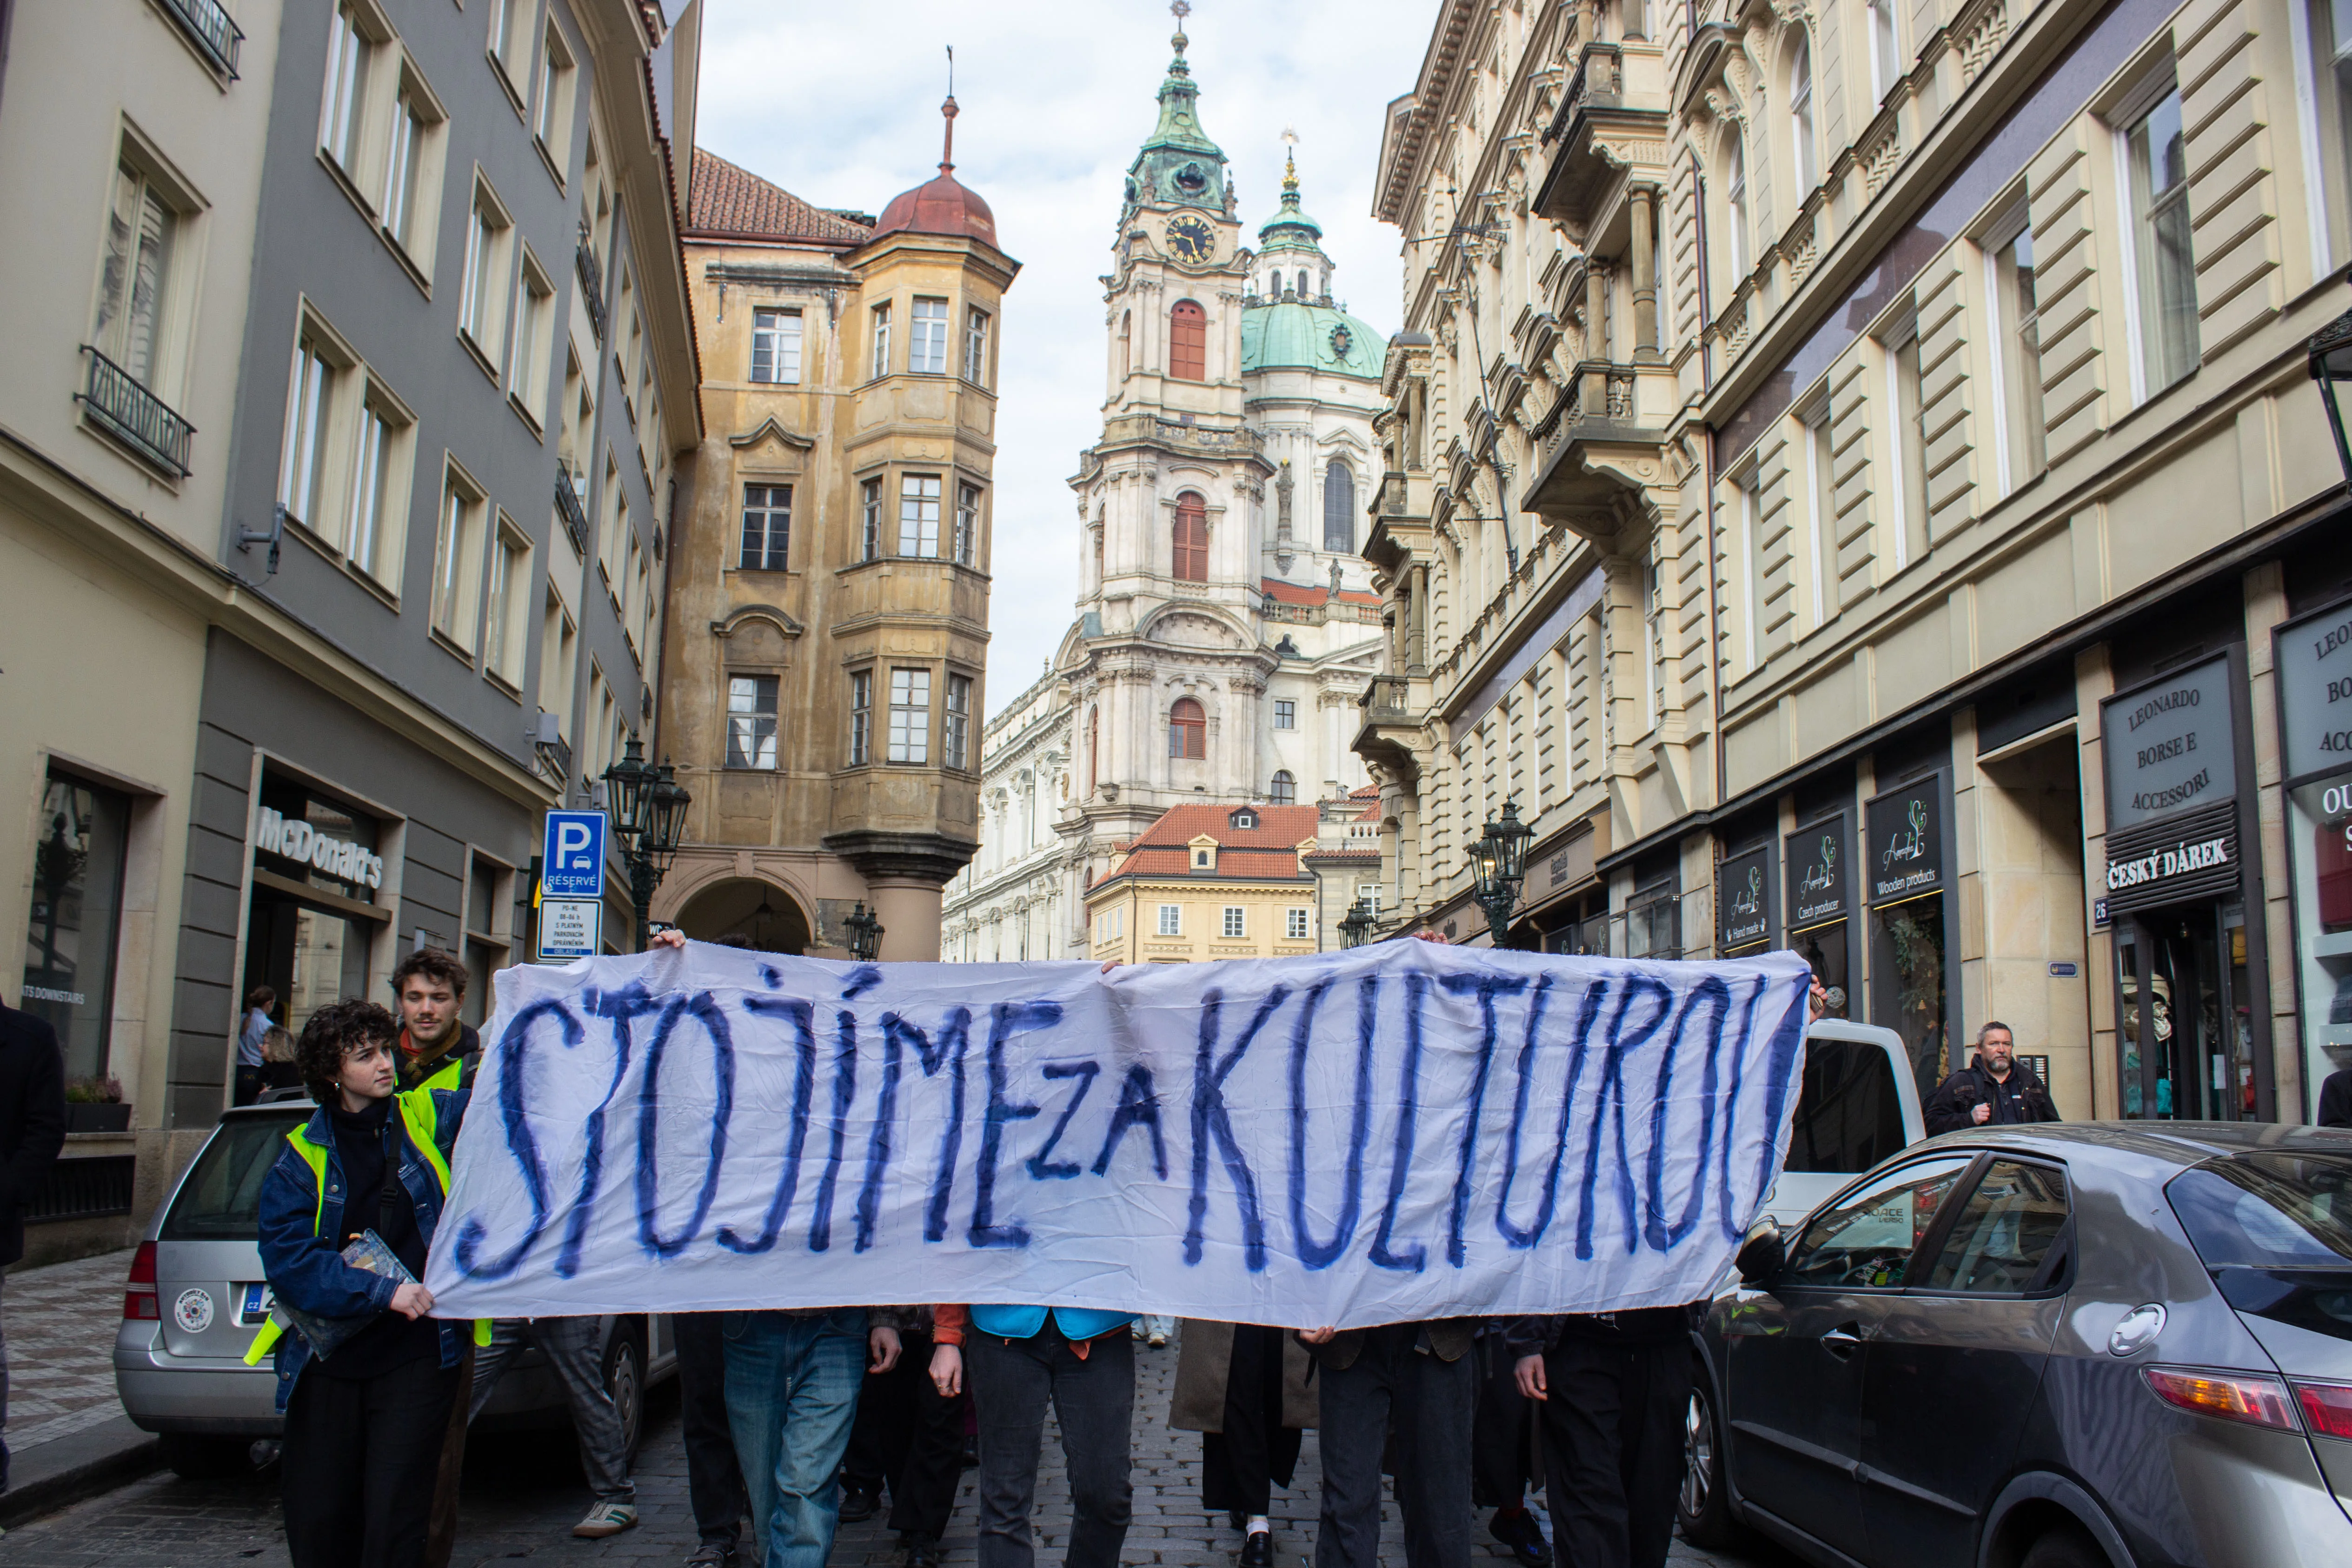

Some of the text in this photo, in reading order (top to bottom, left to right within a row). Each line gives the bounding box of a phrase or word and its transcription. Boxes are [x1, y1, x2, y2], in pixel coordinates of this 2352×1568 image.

[2128, 689, 2199, 732] LEONARDO
[2137, 732, 2197, 769] BORSE E
[2132, 768, 2210, 810] ACCESSORI
[257, 806, 383, 889] McDonald's
[556, 822, 592, 869] P
[2107, 838, 2228, 890] ČESKÝ DÁREK
[547, 873, 597, 886] RÉSERVÉ
[1877, 869, 1935, 895] Wooden products
[1798, 899, 1839, 919] Czech producer
[2096, 903, 2106, 920] 26
[1733, 921, 1759, 939] Hand made
[35, 986, 85, 1005] DOWNSTAIRS
[453, 963, 1812, 1280] STOJÍME ZA KULTUROU
